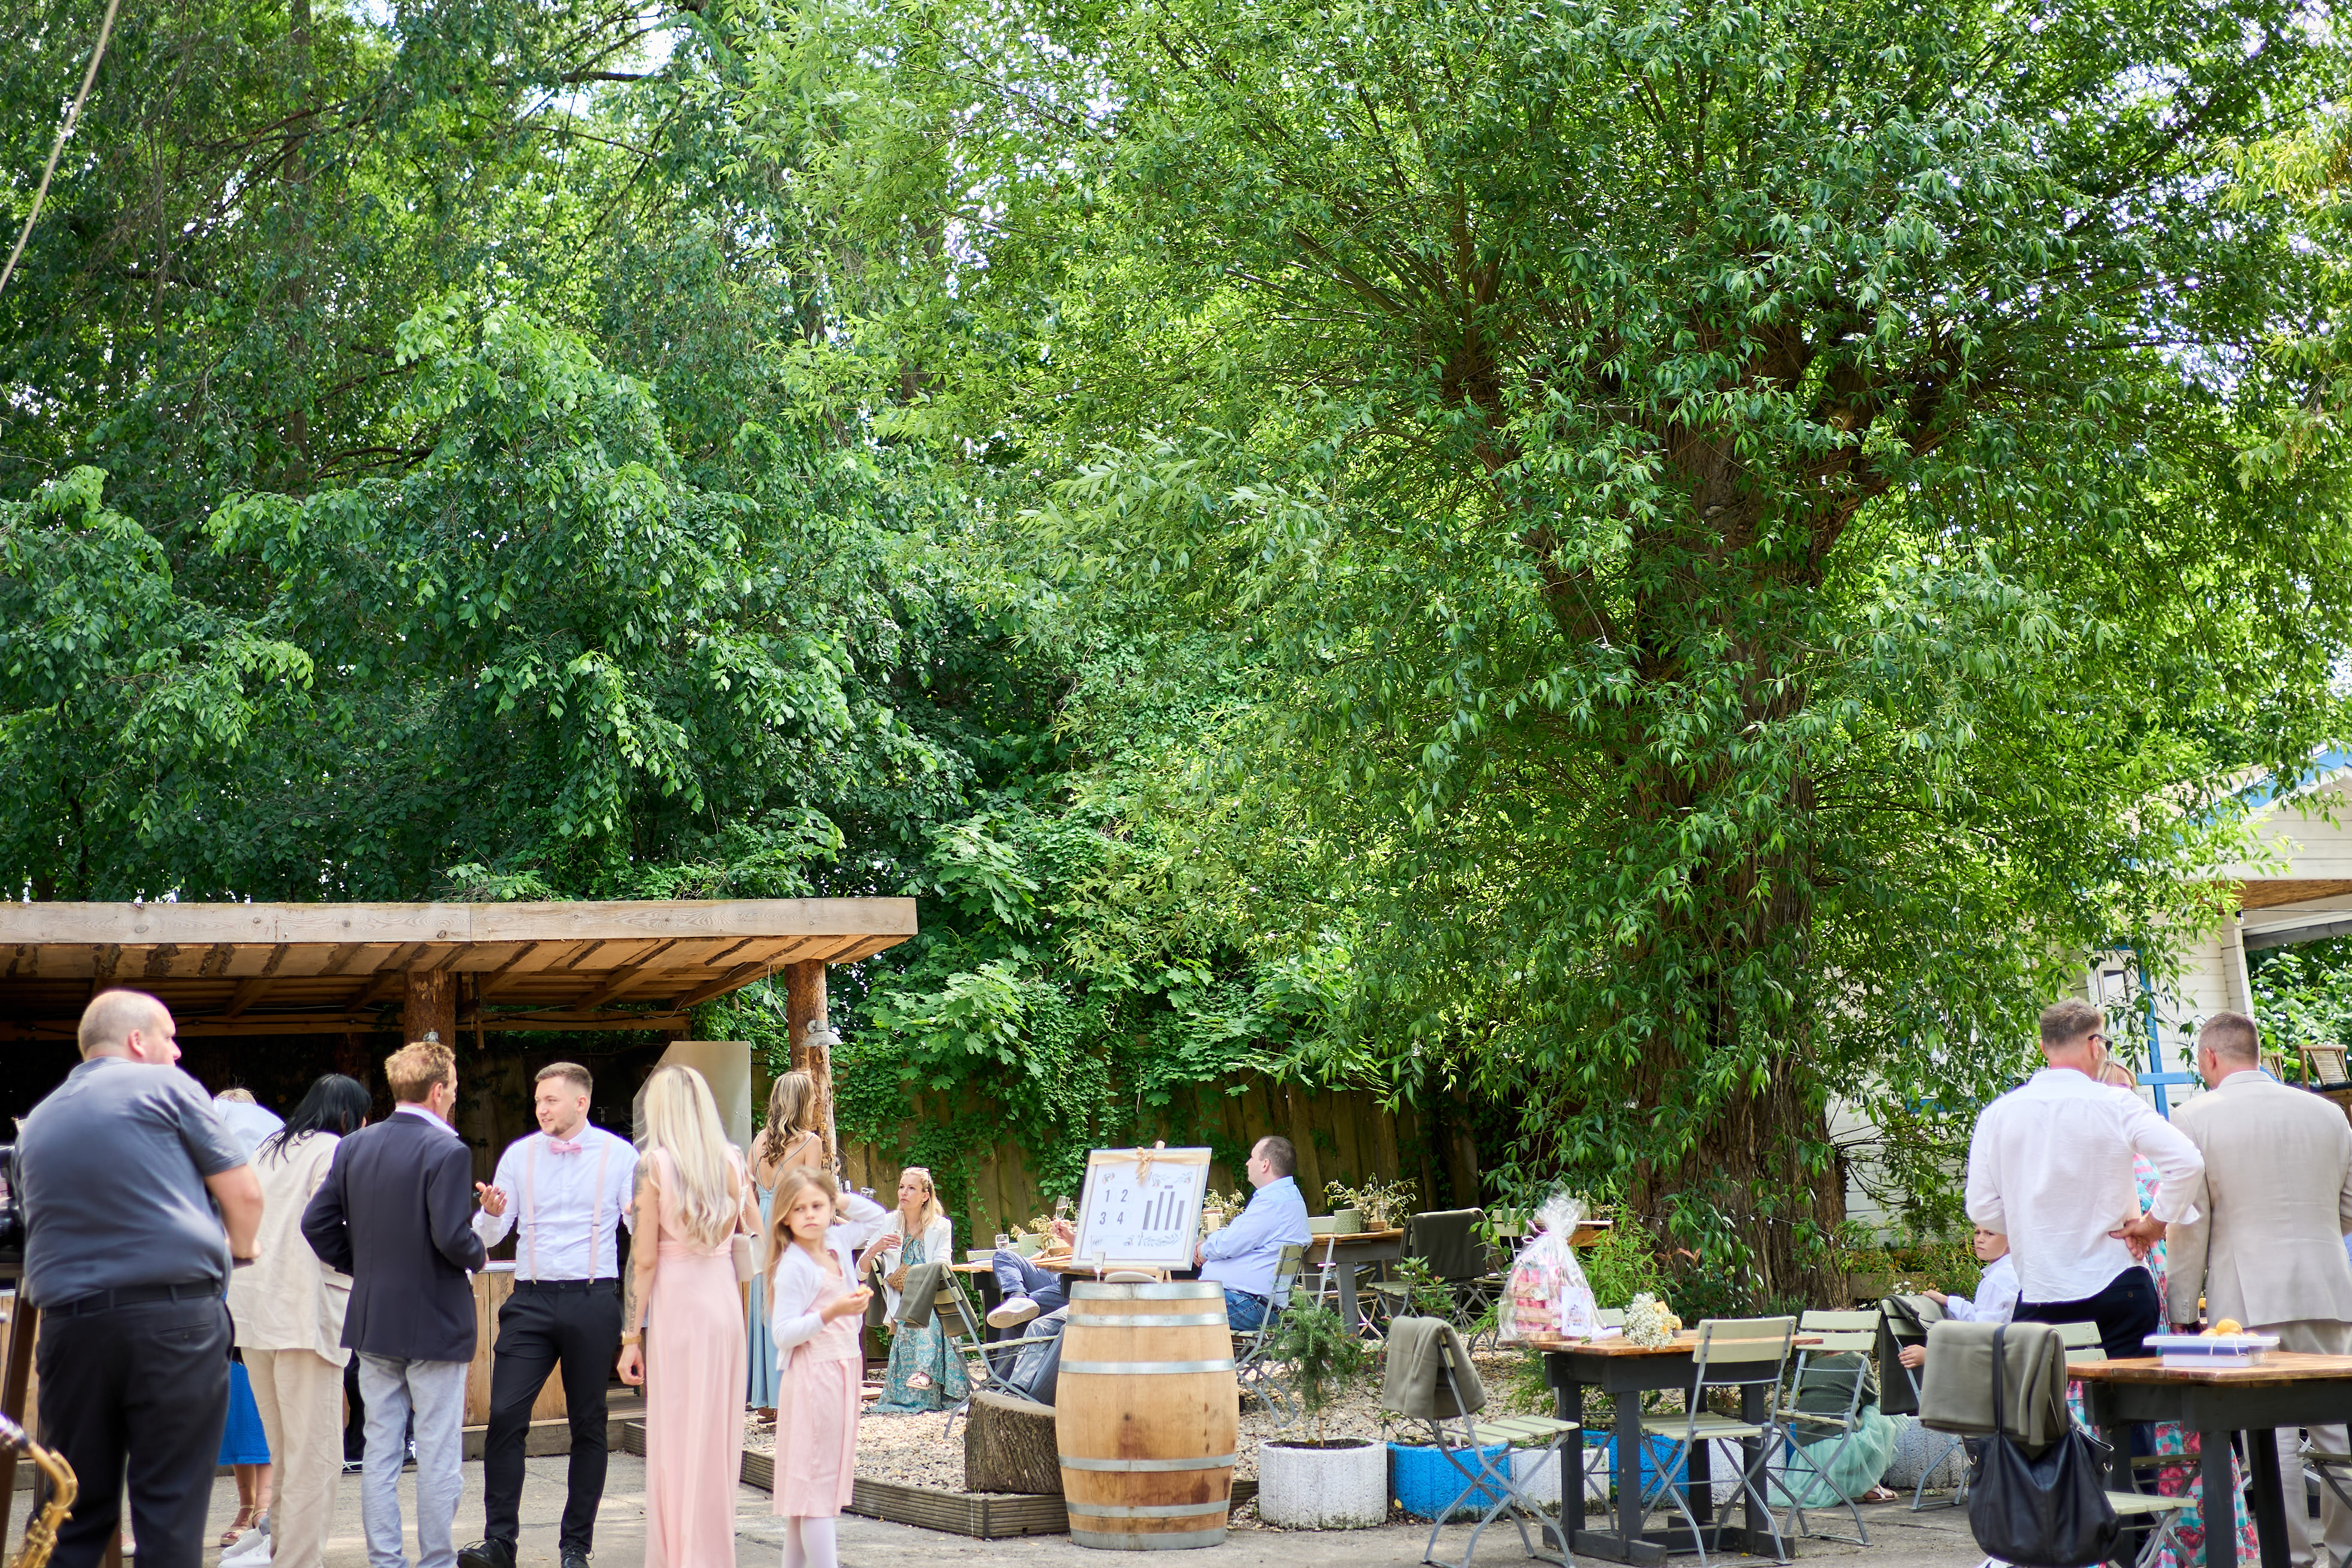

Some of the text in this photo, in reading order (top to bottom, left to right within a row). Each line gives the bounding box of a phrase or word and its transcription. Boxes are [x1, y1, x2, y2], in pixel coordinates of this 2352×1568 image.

[1106, 1189, 1110, 1202] 1
[1120, 1189, 1128, 1202] 2
[1099, 1211, 1107, 1225] 3
[1117, 1211, 1124, 1225] 4
